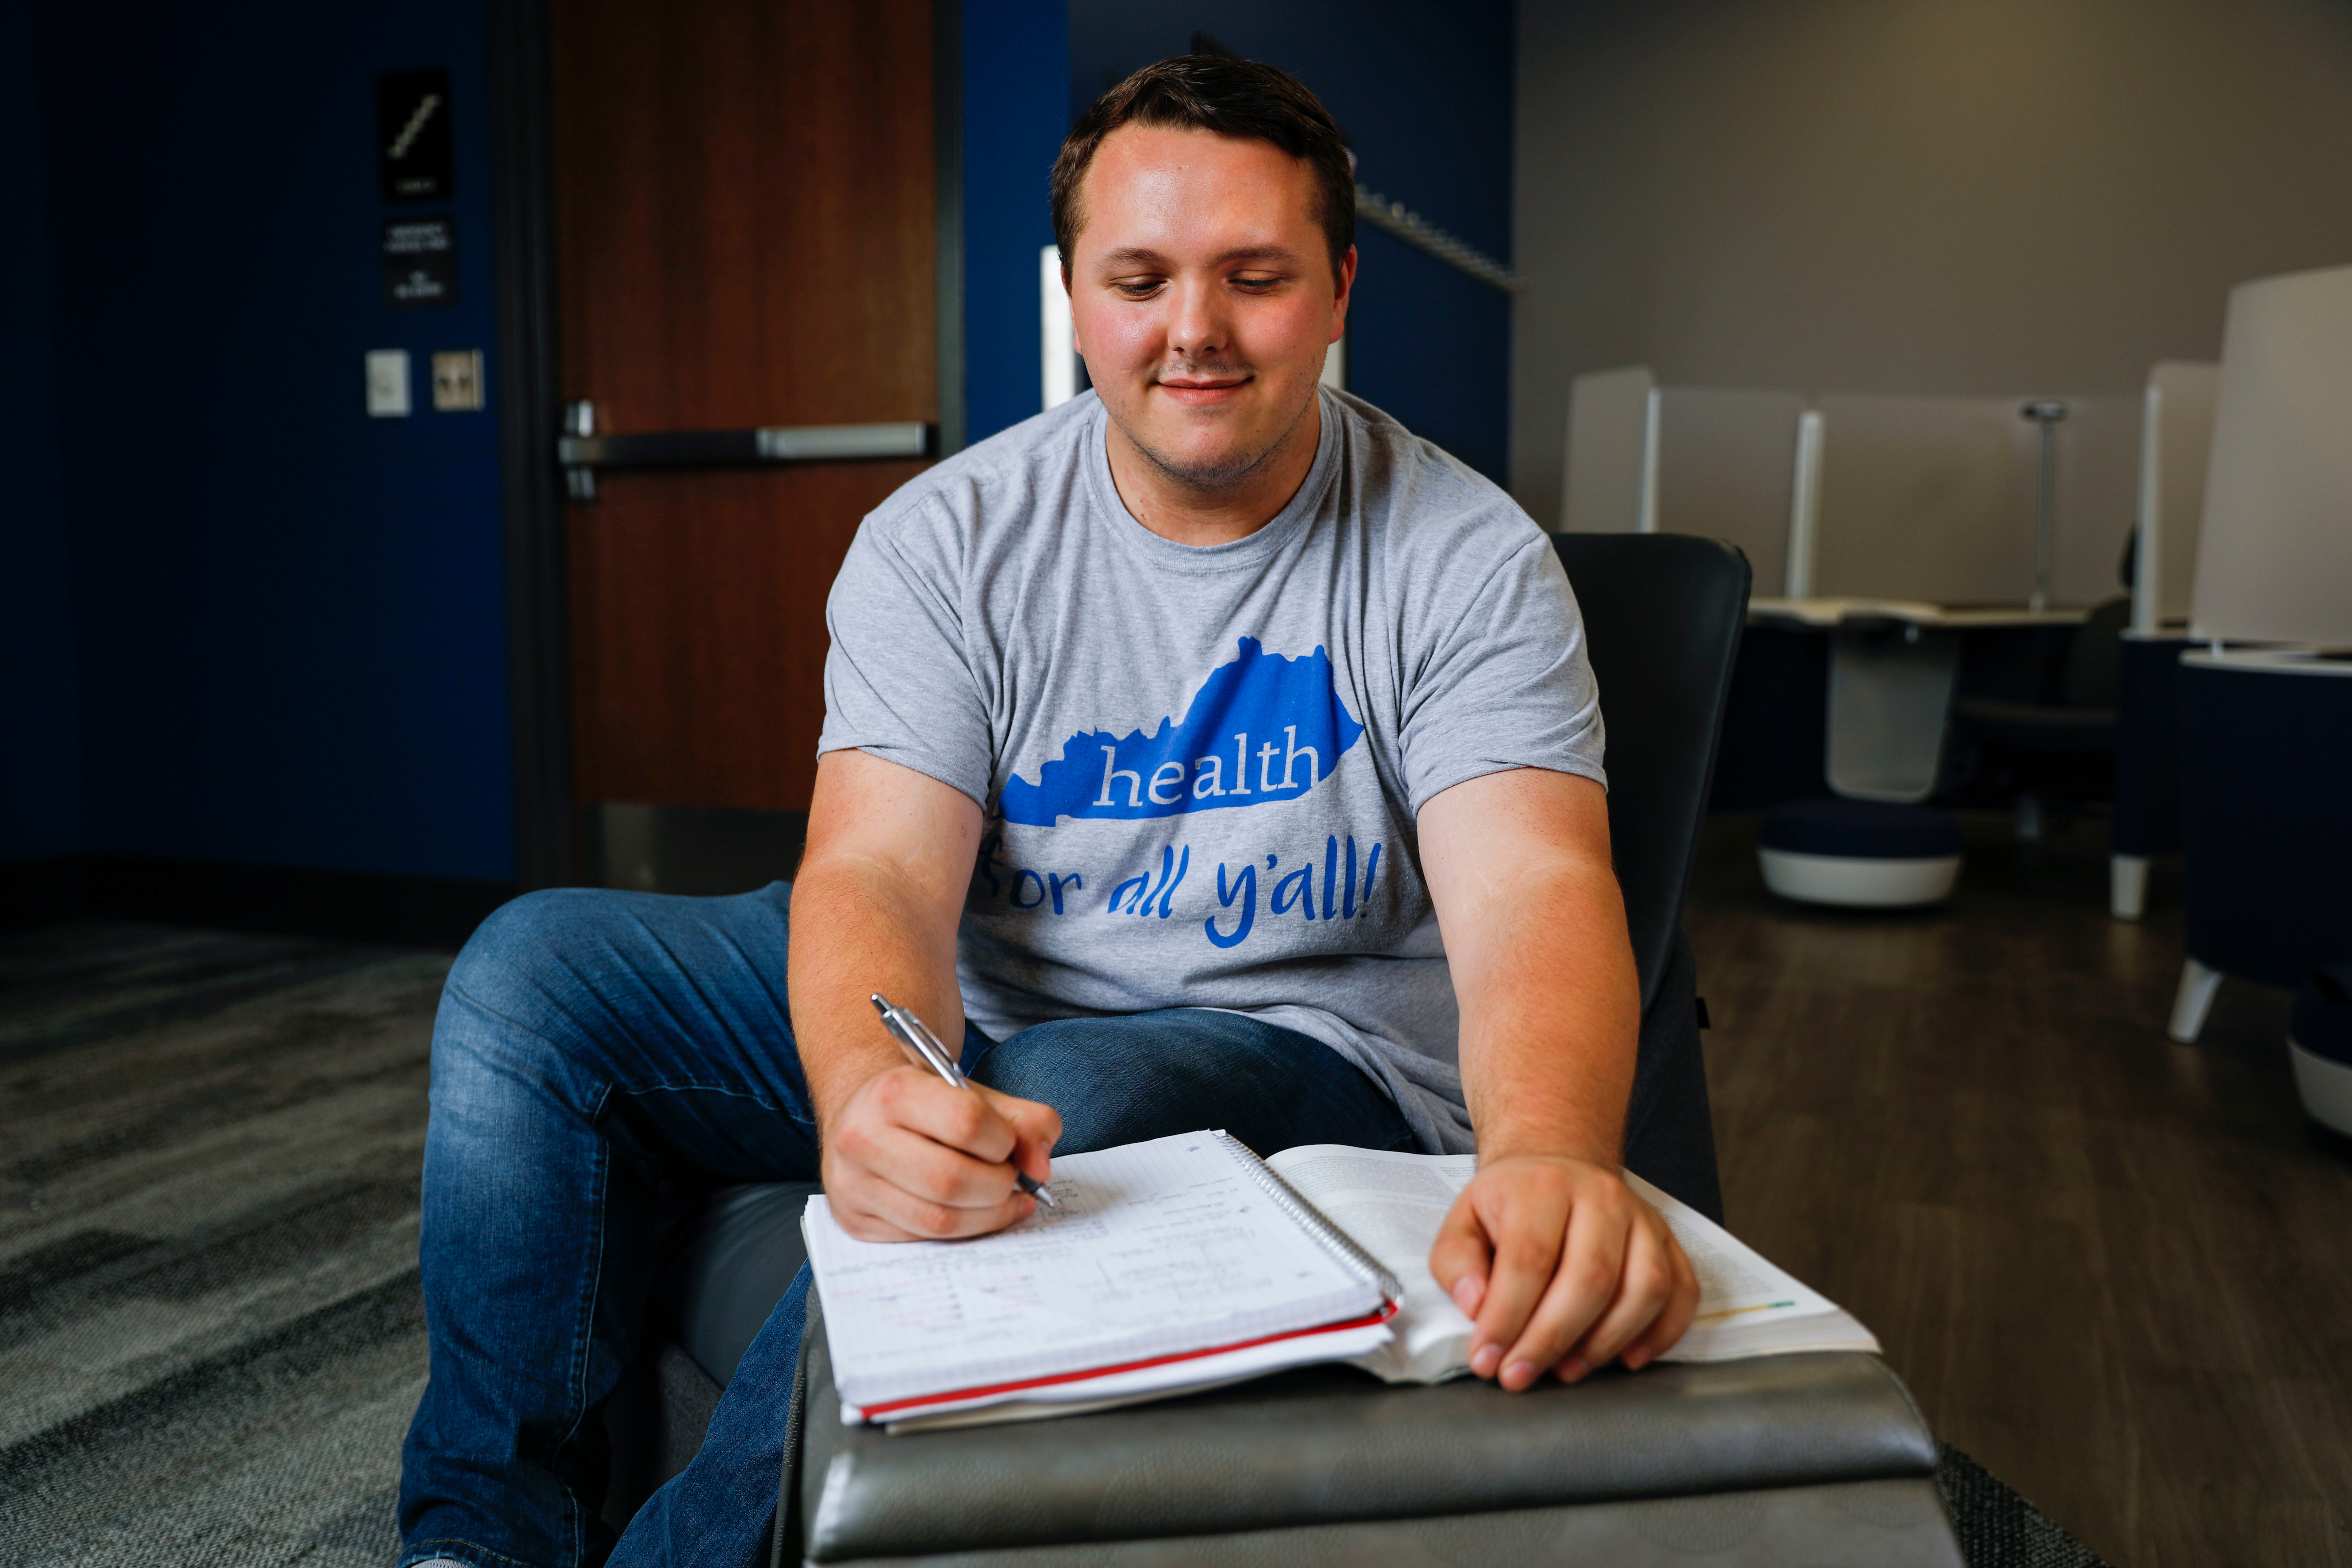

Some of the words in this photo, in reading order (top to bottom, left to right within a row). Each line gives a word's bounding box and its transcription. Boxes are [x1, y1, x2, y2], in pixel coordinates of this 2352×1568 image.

[1093, 726, 1319, 807] health
[978, 834, 1081, 915] for
[1108, 845, 1189, 919] all
[1204, 834, 1382, 949] y'all!
